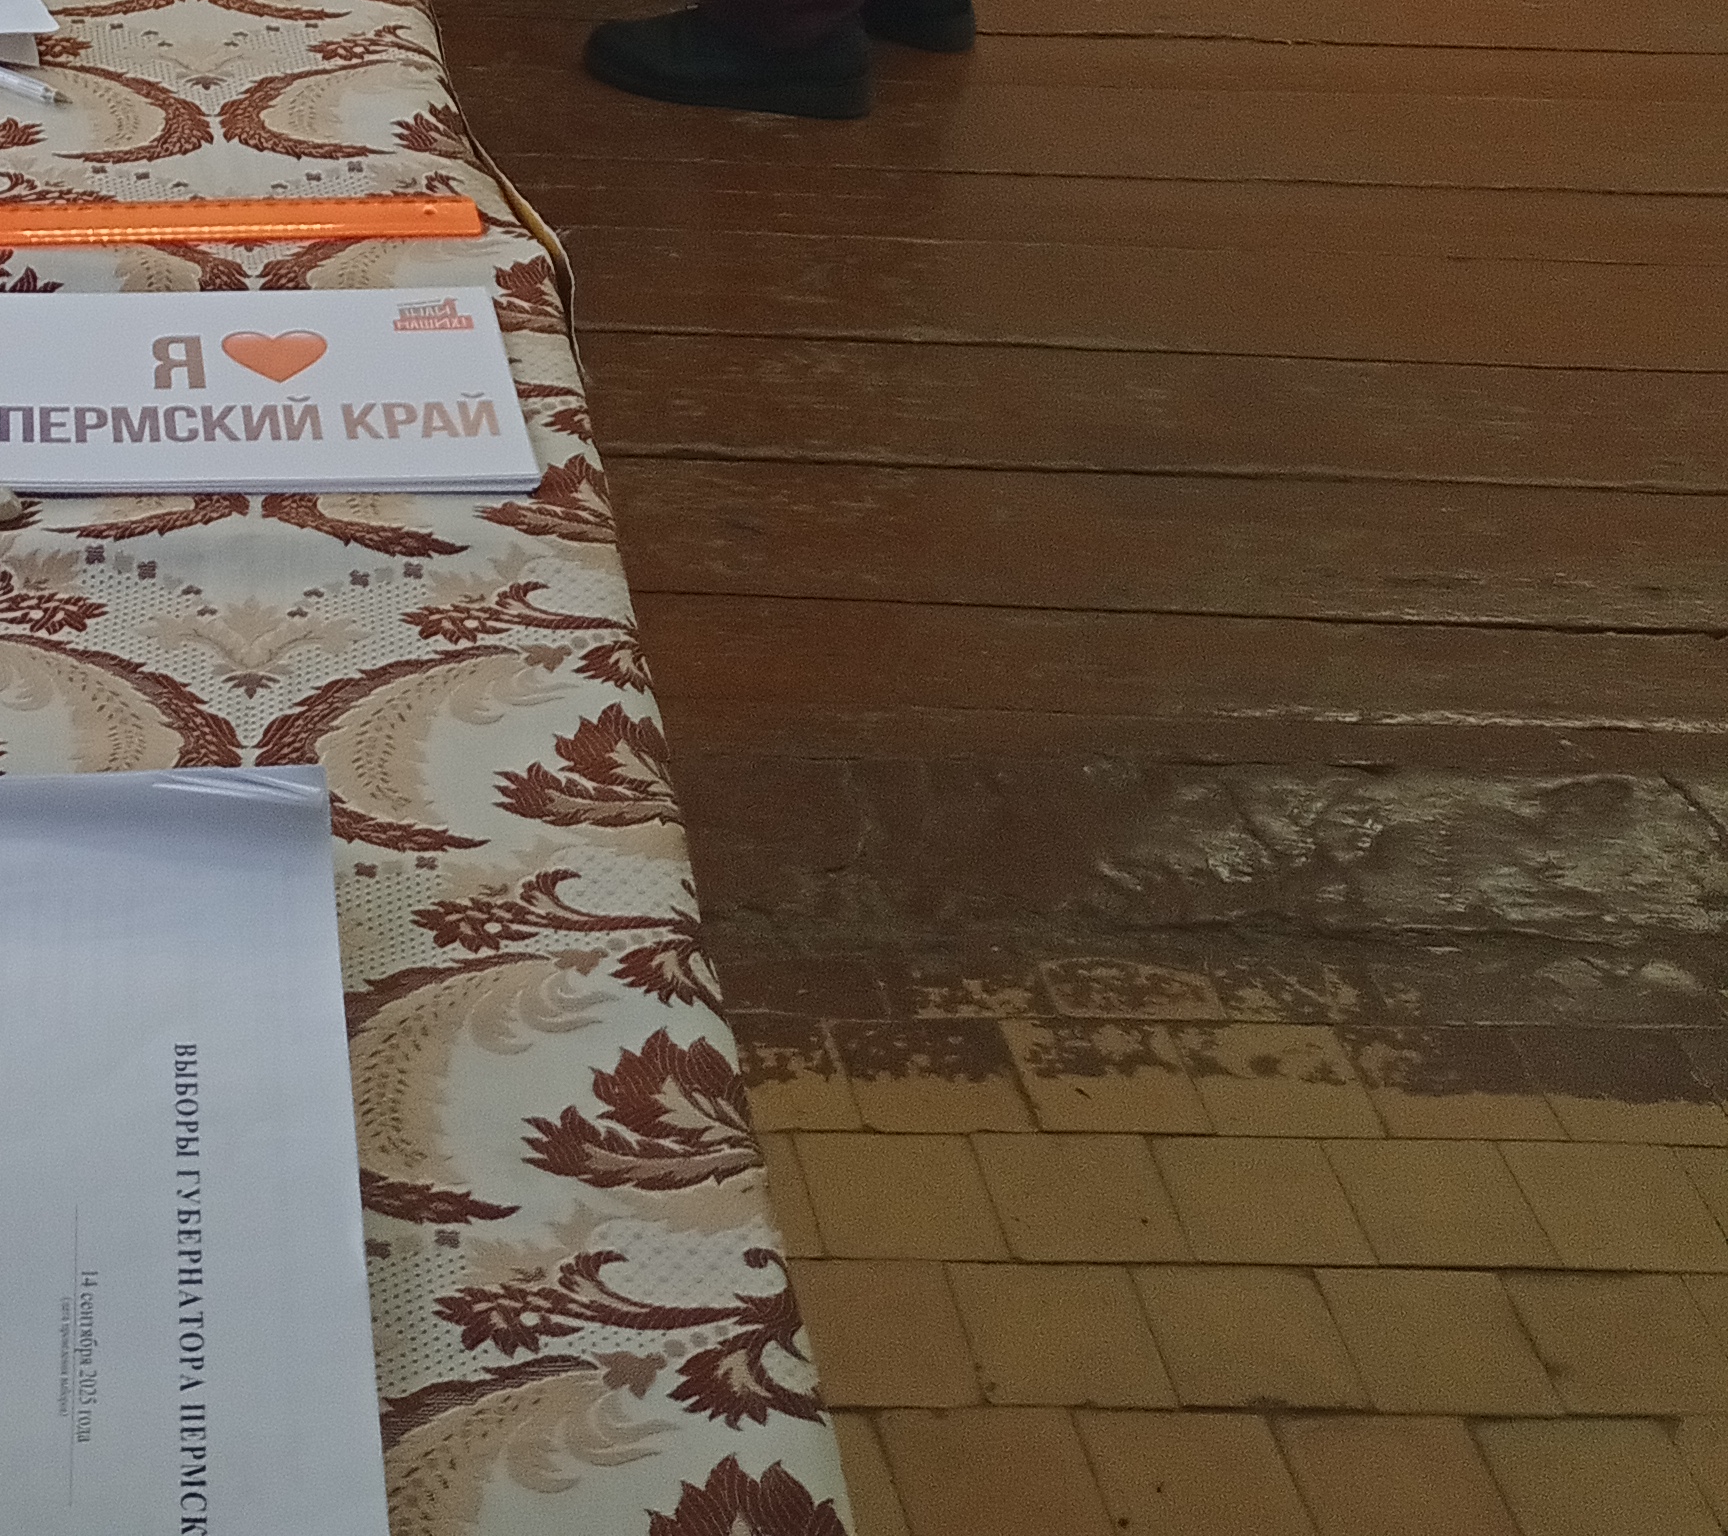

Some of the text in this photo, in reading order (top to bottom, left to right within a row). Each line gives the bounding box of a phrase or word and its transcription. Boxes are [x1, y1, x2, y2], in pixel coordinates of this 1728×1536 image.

[152, 334, 206, 390] Я
[341, 391, 502, 441] КРАЙ
[174, 1044, 199, 1157] ВЫБОРЫ
[176, 1170, 206, 1391] ГУБЕРНАТОРА
[75, 1270, 99, 1442] 14 сентября 2025 года
